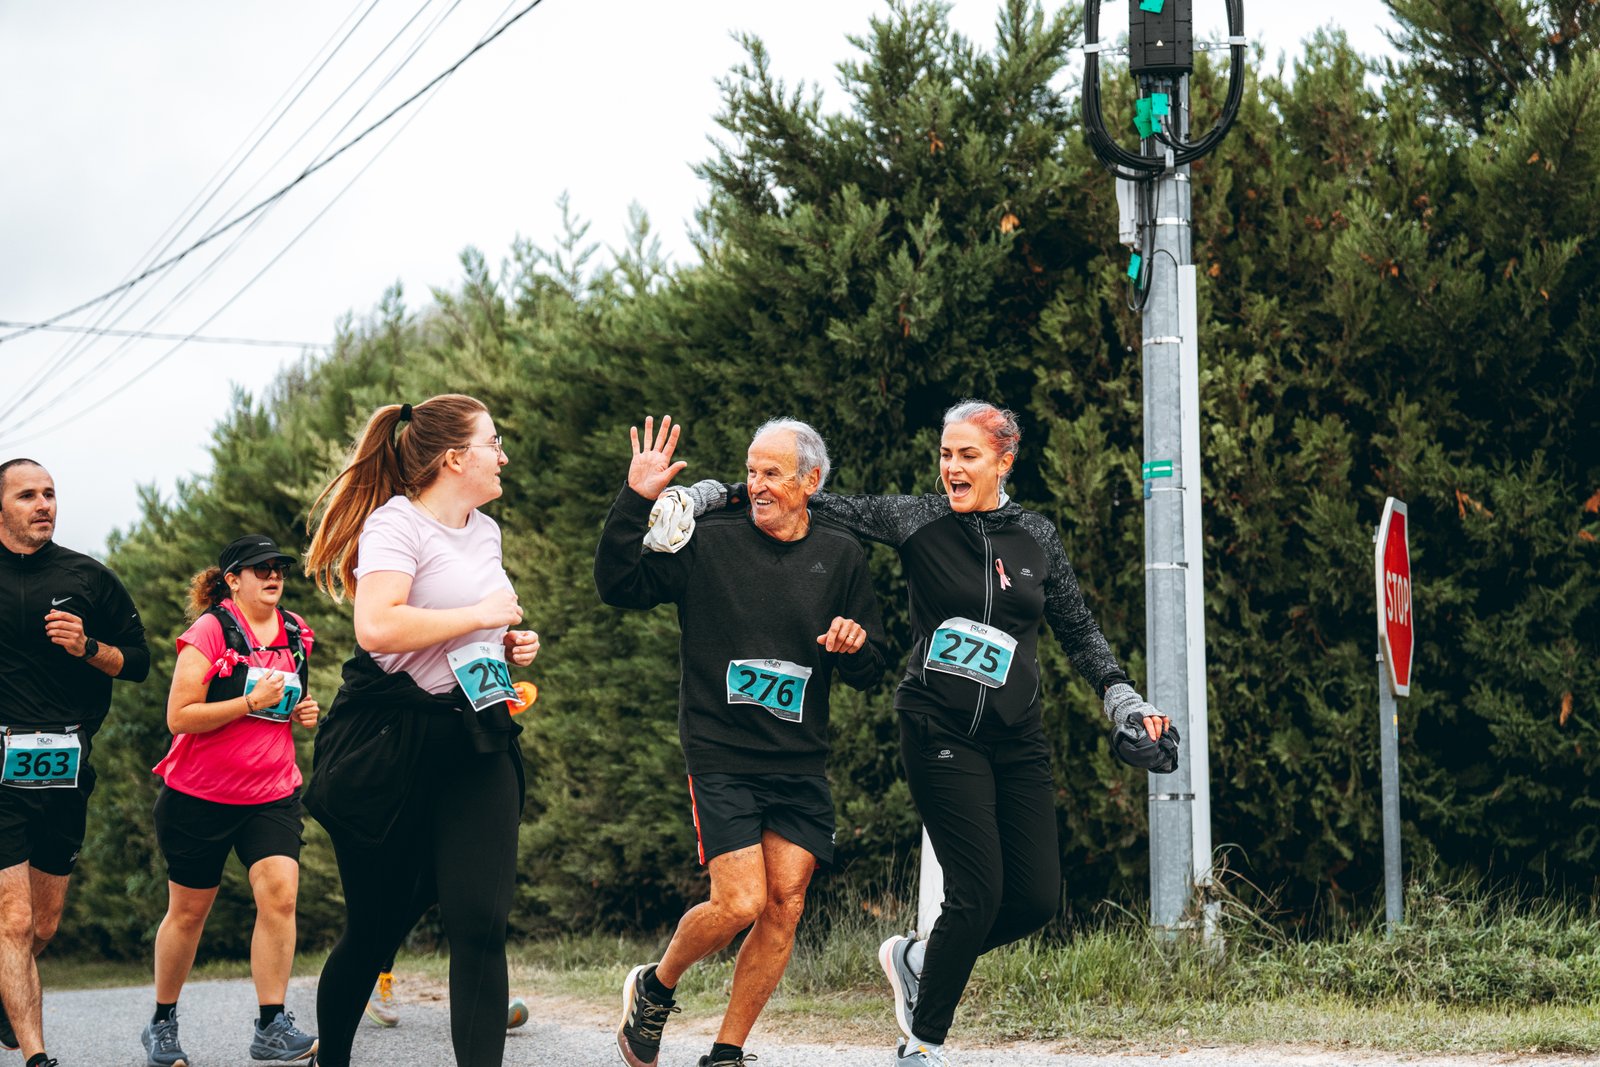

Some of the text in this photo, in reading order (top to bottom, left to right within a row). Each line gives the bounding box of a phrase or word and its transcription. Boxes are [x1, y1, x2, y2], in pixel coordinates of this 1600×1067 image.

[1386, 569, 1409, 627] STOP
[939, 634, 1001, 673] 275
[738, 669, 796, 707] 276
[13, 751, 70, 777] 363
